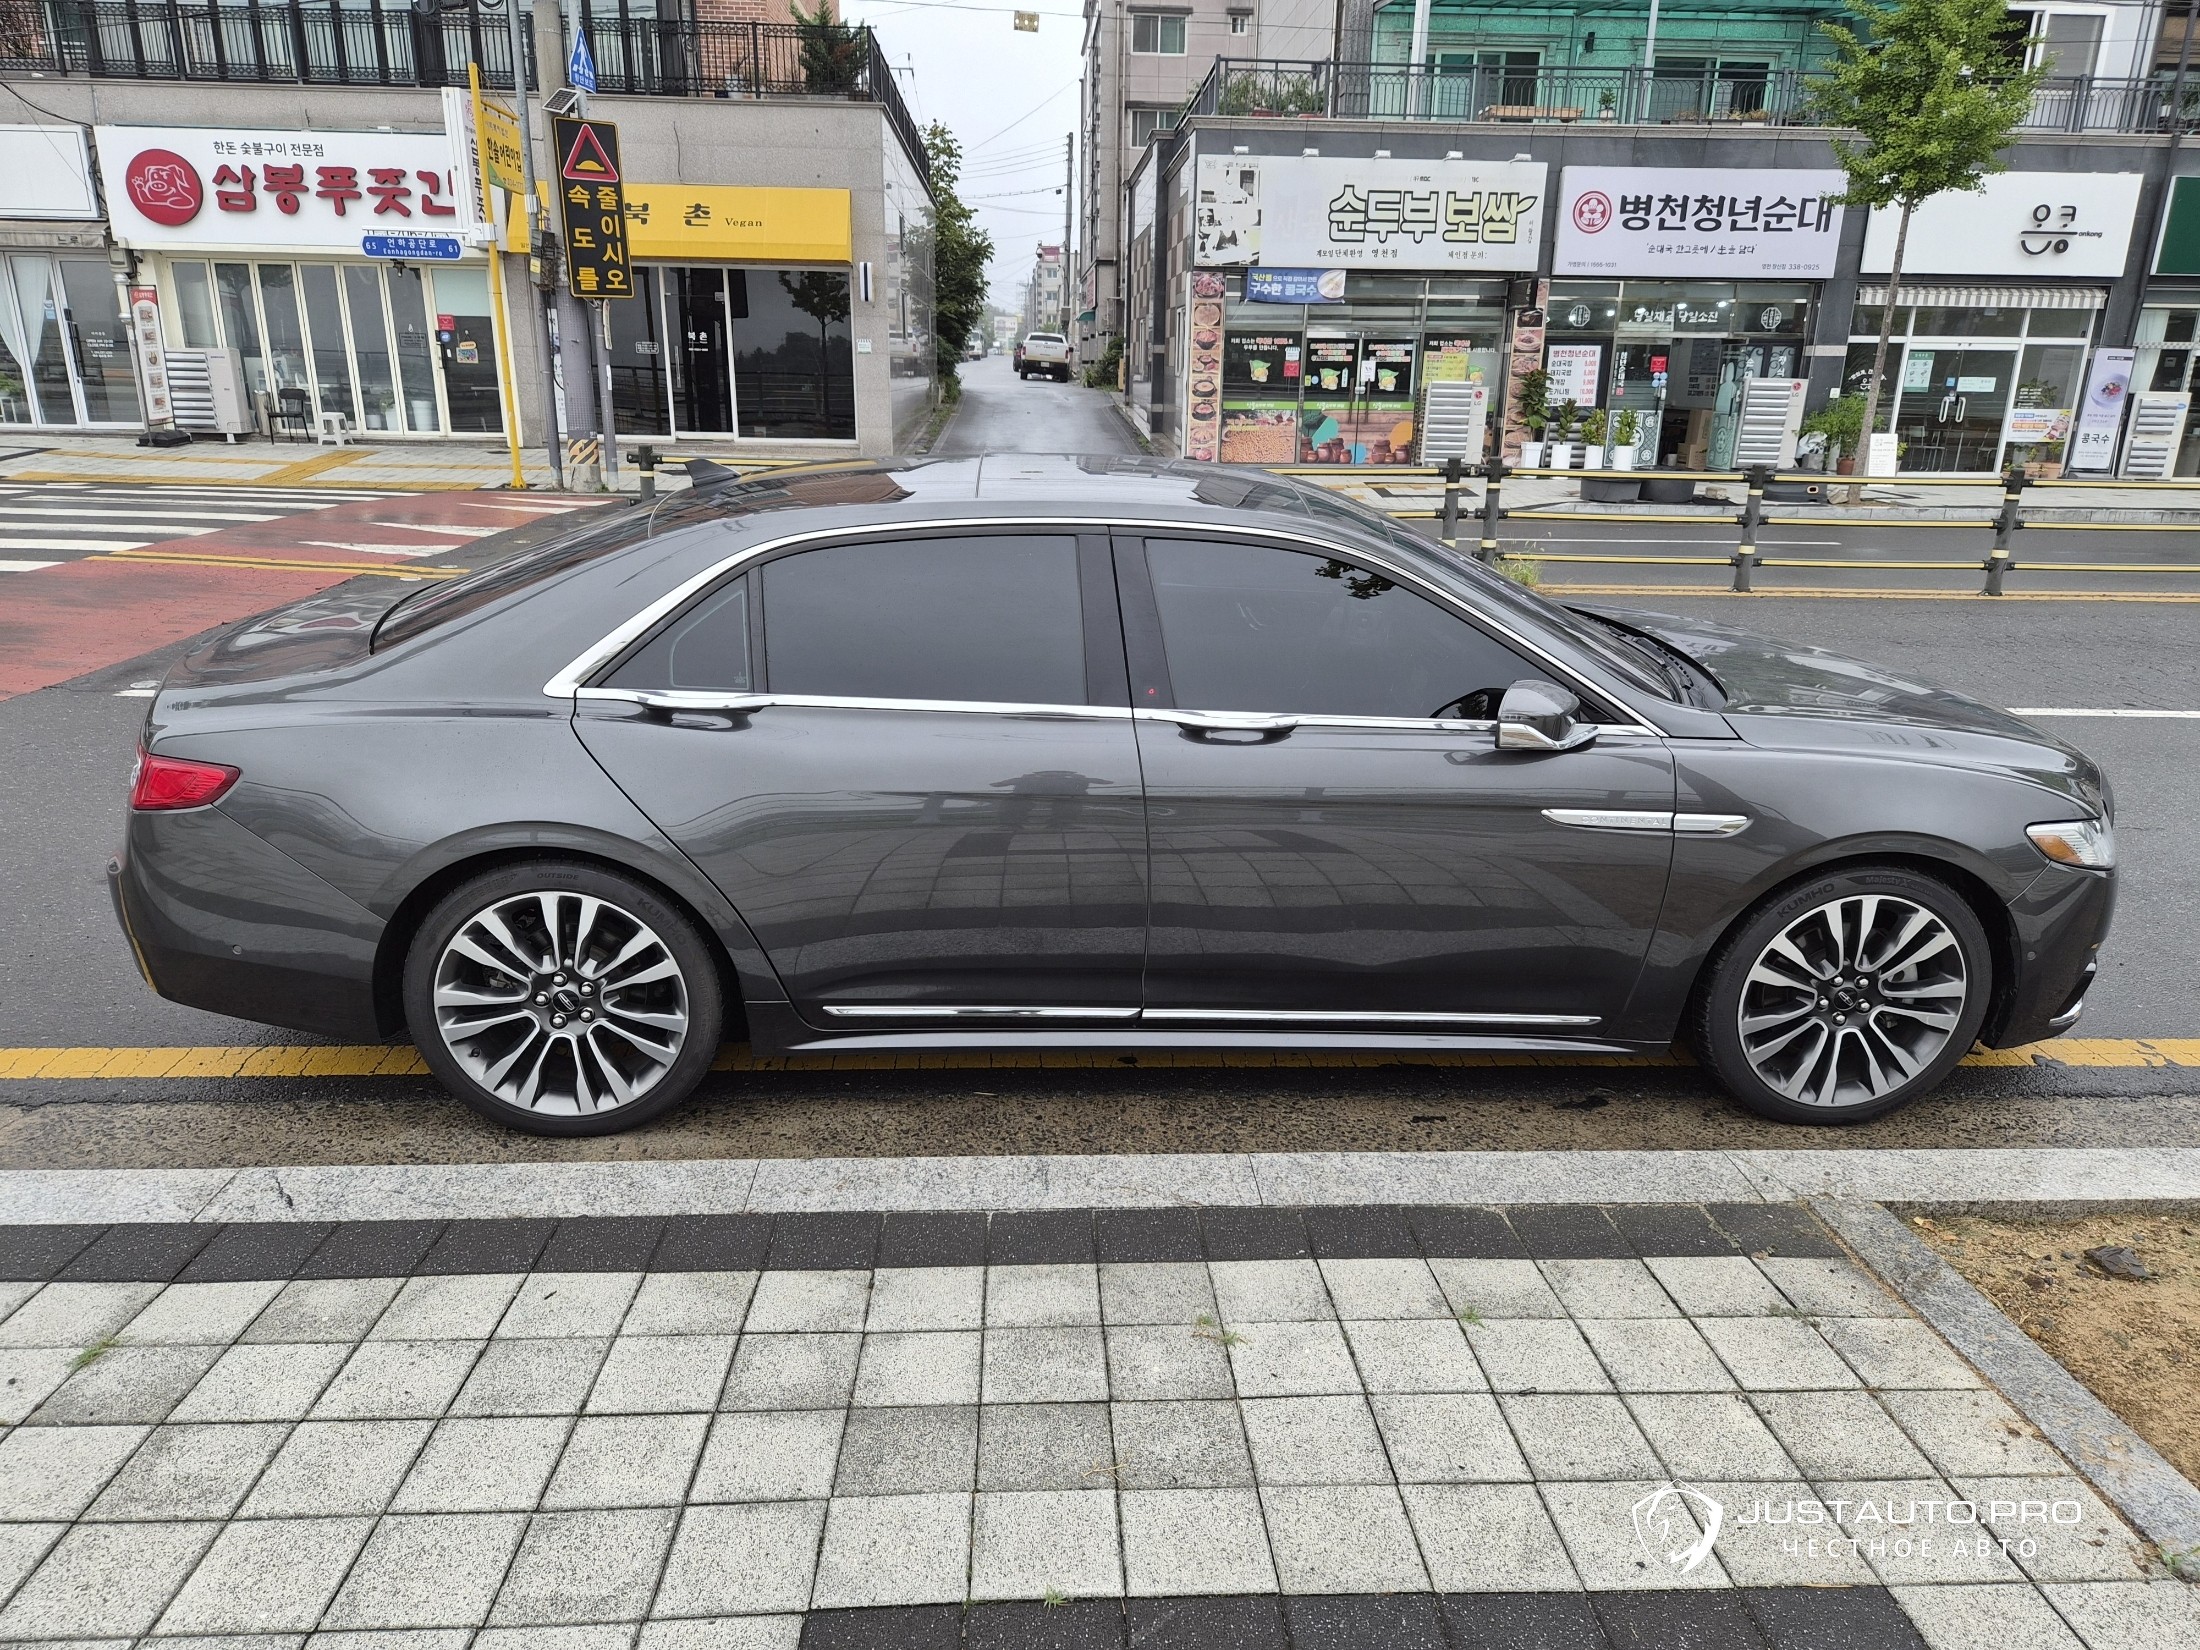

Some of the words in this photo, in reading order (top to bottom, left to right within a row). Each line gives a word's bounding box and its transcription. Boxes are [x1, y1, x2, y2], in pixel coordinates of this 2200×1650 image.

[213, 141, 237, 155] 한돈
[240, 143, 287, 156] 숯불구이
[290, 143, 324, 157] 전문점
[487, 137, 522, 173] 한솔어린이집
[1328, 185, 1439, 243] 순두부
[1442, 191, 1535, 244] 보쌈
[1620, 194, 1833, 232] 병천청년순대
[725, 217, 763, 227] Vegan
[568, 185, 599, 290] 속도를
[597, 187, 627, 290] 줄이시오
[365, 241, 377, 250] 65
[387, 238, 437, 249] 언하공단로
[448, 243, 458, 253] 61
[1675, 244, 1708, 255] 한그릇에
[1372, 249, 1398, 258] 영천점
[1448, 250, 1468, 259] 체인점
[1788, 263, 1820, 271] 338-0925
[1250, 282, 1282, 296] 구수한
[1285, 283, 1317, 296] 콩국수
[1634, 309, 1675, 322] 당일재료
[1678, 310, 1718, 323] 당일소진
[1553, 350, 1596, 358] 병천청년순대
[1777, 355, 1787, 378] 정식
[2081, 433, 2110, 444] 콩국수
[1581, 816, 1667, 826] CONTINENTAL
[537, 872, 579, 881] OUTSIDE
[1777, 883, 1835, 919] KUMHO
